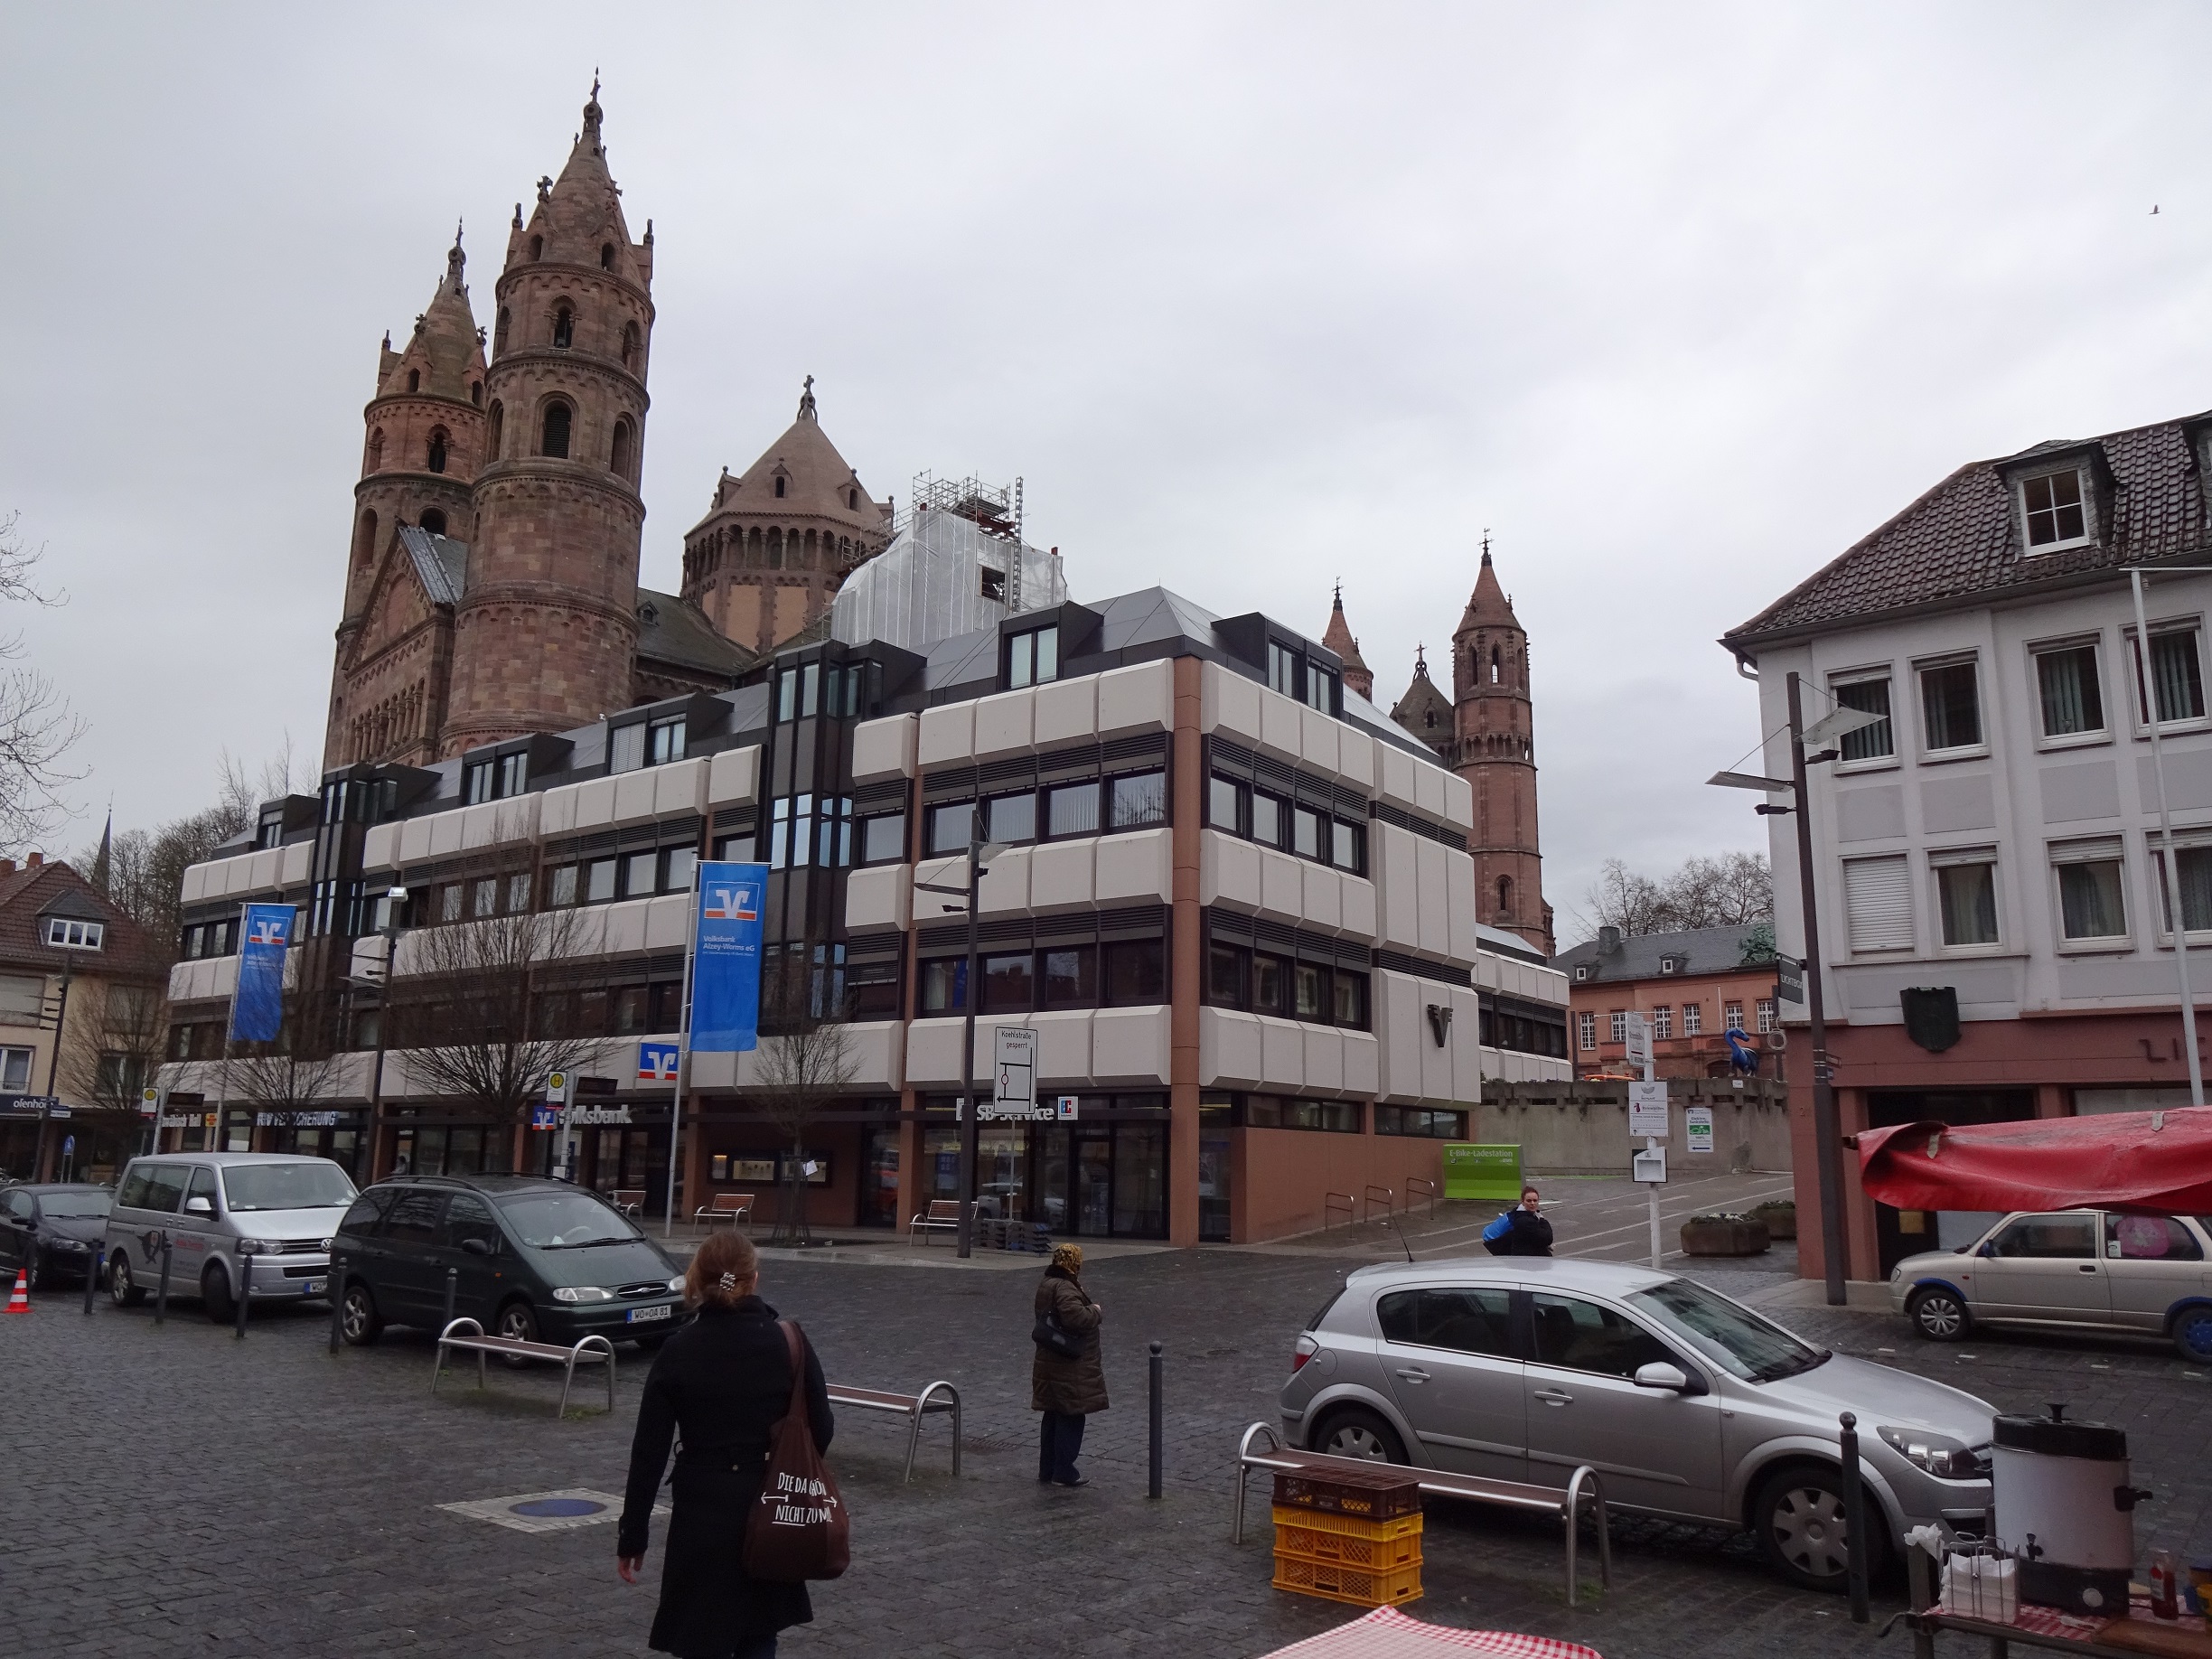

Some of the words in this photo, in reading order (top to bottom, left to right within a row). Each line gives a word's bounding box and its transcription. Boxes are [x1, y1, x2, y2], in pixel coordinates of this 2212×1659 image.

[703, 942, 745, 951] Alzey-Worms
[1006, 1041, 1028, 1049] gesperrt
[1449, 1149, 1514, 1158] E-Bike-Ladestation
[659, 1307, 669, 1316] 81
[777, 1472, 795, 1493] DIE
[795, 1476, 808, 1494] DA
[774, 1504, 806, 1523] NICHT
[806, 1507, 819, 1523] ZU
